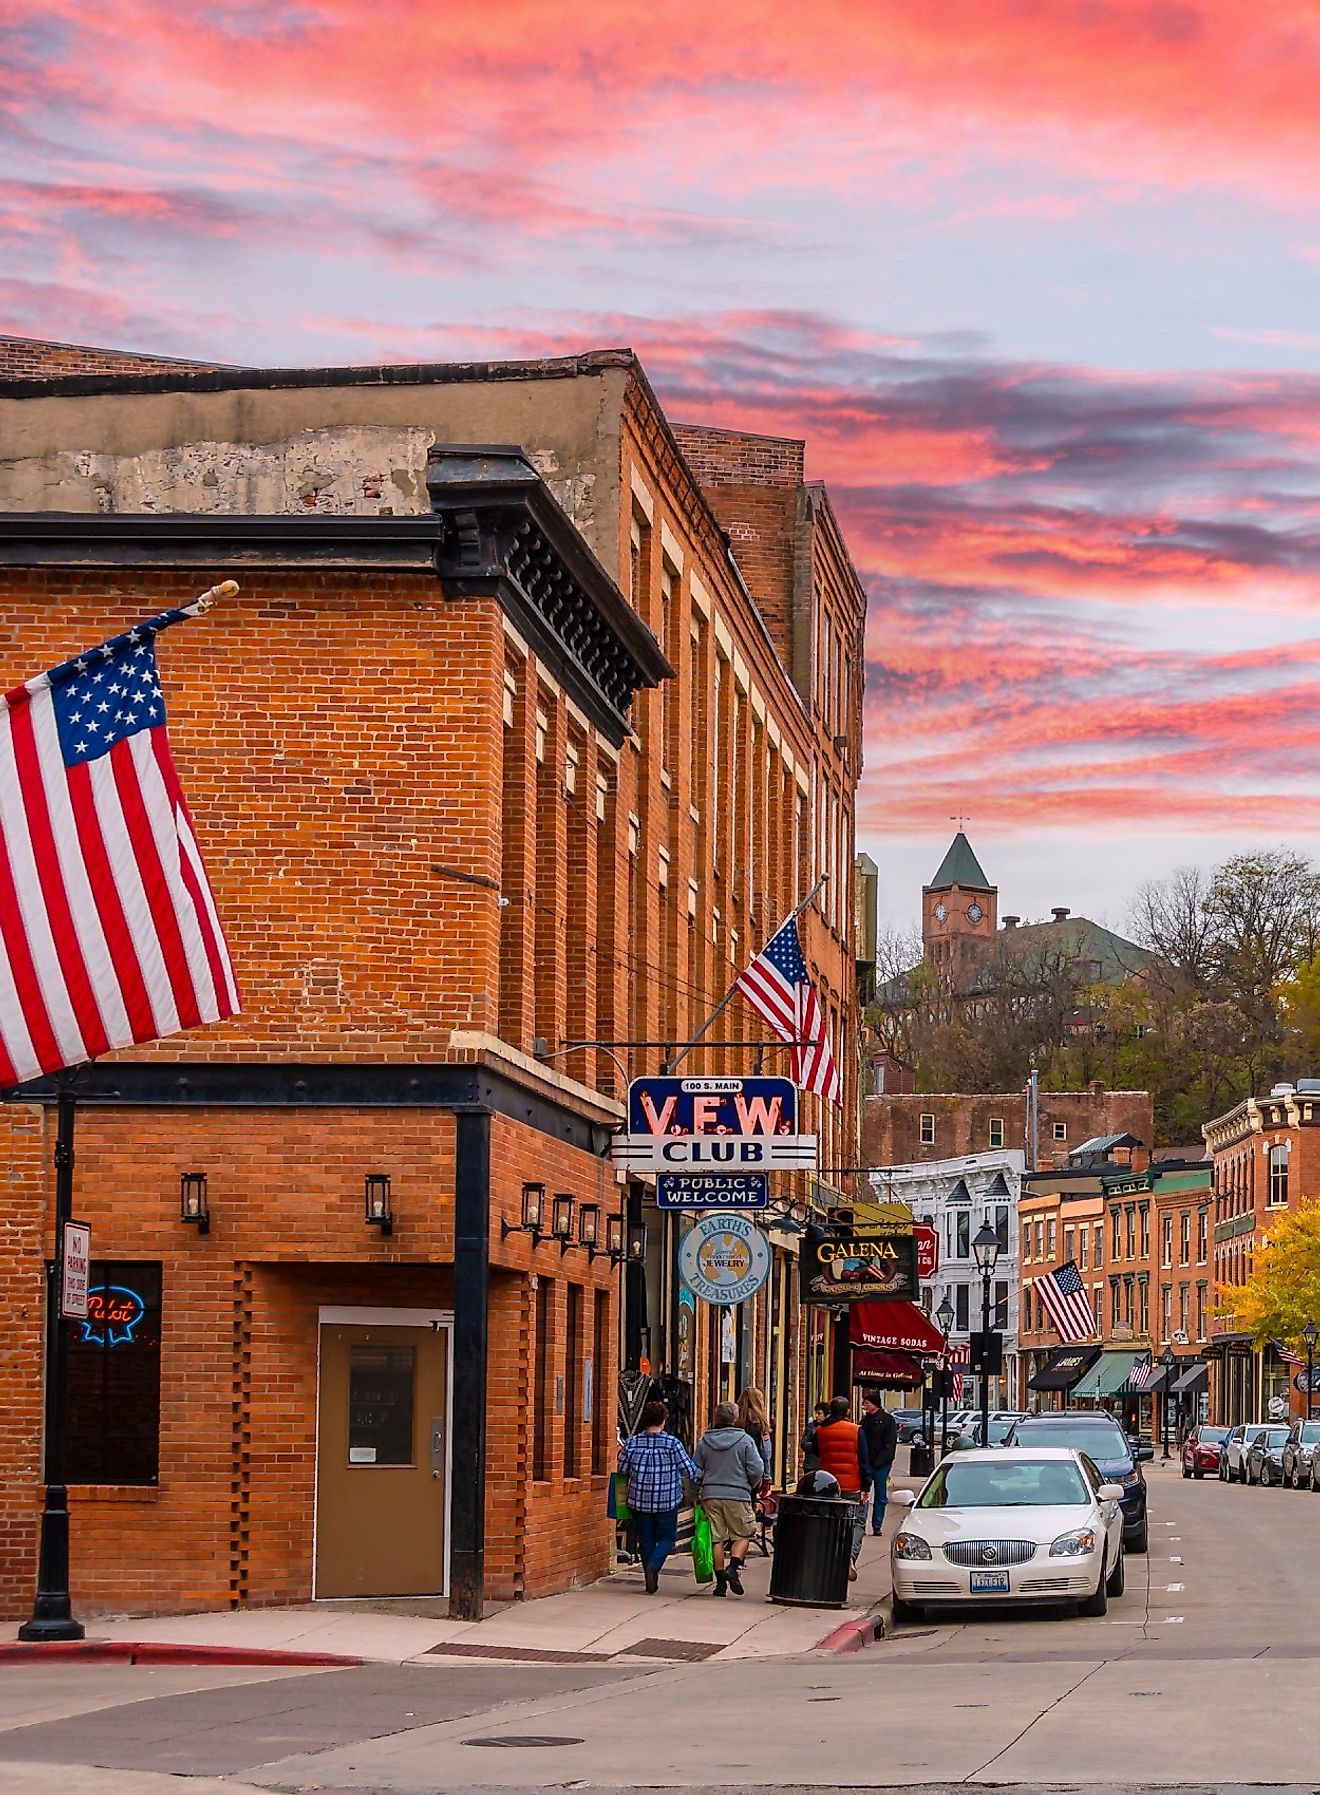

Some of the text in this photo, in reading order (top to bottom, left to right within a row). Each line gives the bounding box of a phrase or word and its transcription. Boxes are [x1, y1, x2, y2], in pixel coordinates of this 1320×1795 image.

[662, 1141, 764, 1162] CLUB
[679, 1178, 746, 1189] PUBLIC
[666, 1191, 759, 1203] WELCOME
[699, 1218, 752, 1237] EARTH'S
[817, 1241, 899, 1263] GALENA
[689, 1272, 760, 1300] TREASURES
[862, 1333, 928, 1348] VINTAGE SODAS
